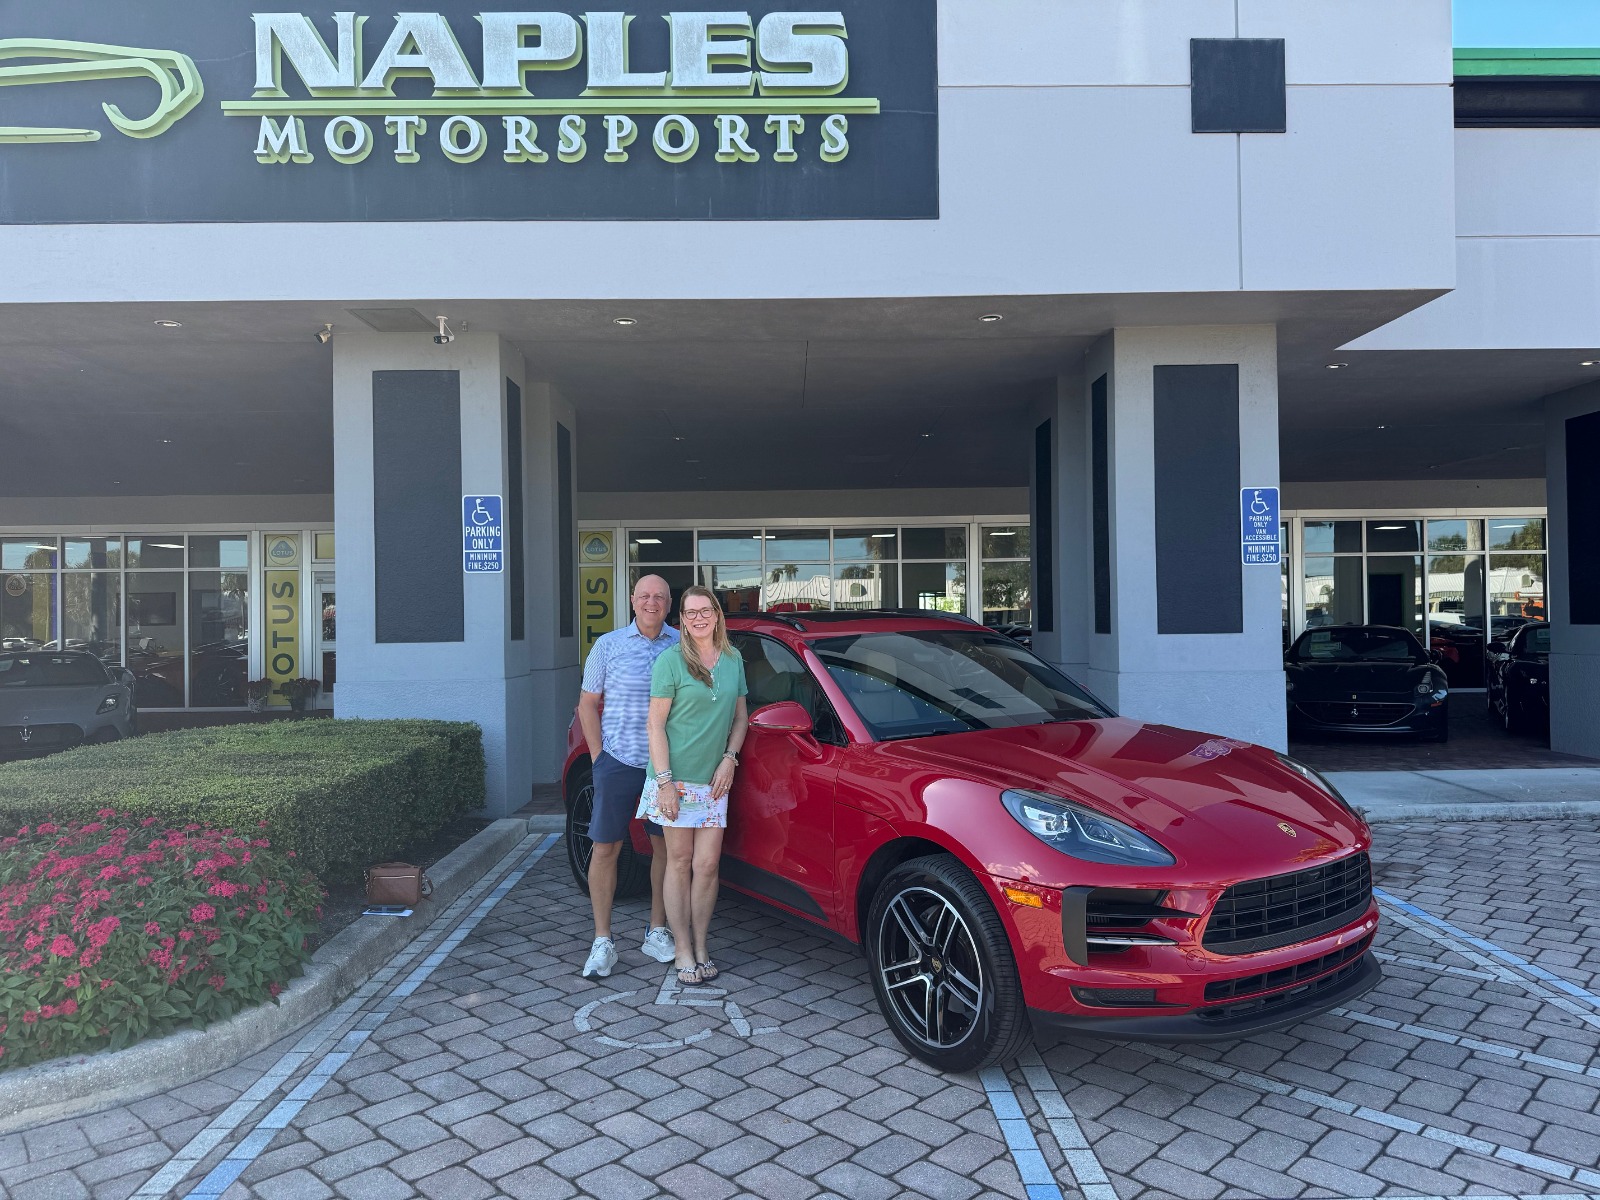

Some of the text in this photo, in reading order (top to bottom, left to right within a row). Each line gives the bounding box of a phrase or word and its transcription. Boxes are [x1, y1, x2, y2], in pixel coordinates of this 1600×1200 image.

[252, 11, 850, 97] NAPLES
[254, 114, 850, 164] MOTORSPORTS
[465, 526, 501, 537] PARKING
[472, 538, 494, 549] ONLY
[1247, 545, 1275, 553] MINIMUM
[469, 553, 497, 561] MINIMUM
[586, 577, 609, 644] TUS
